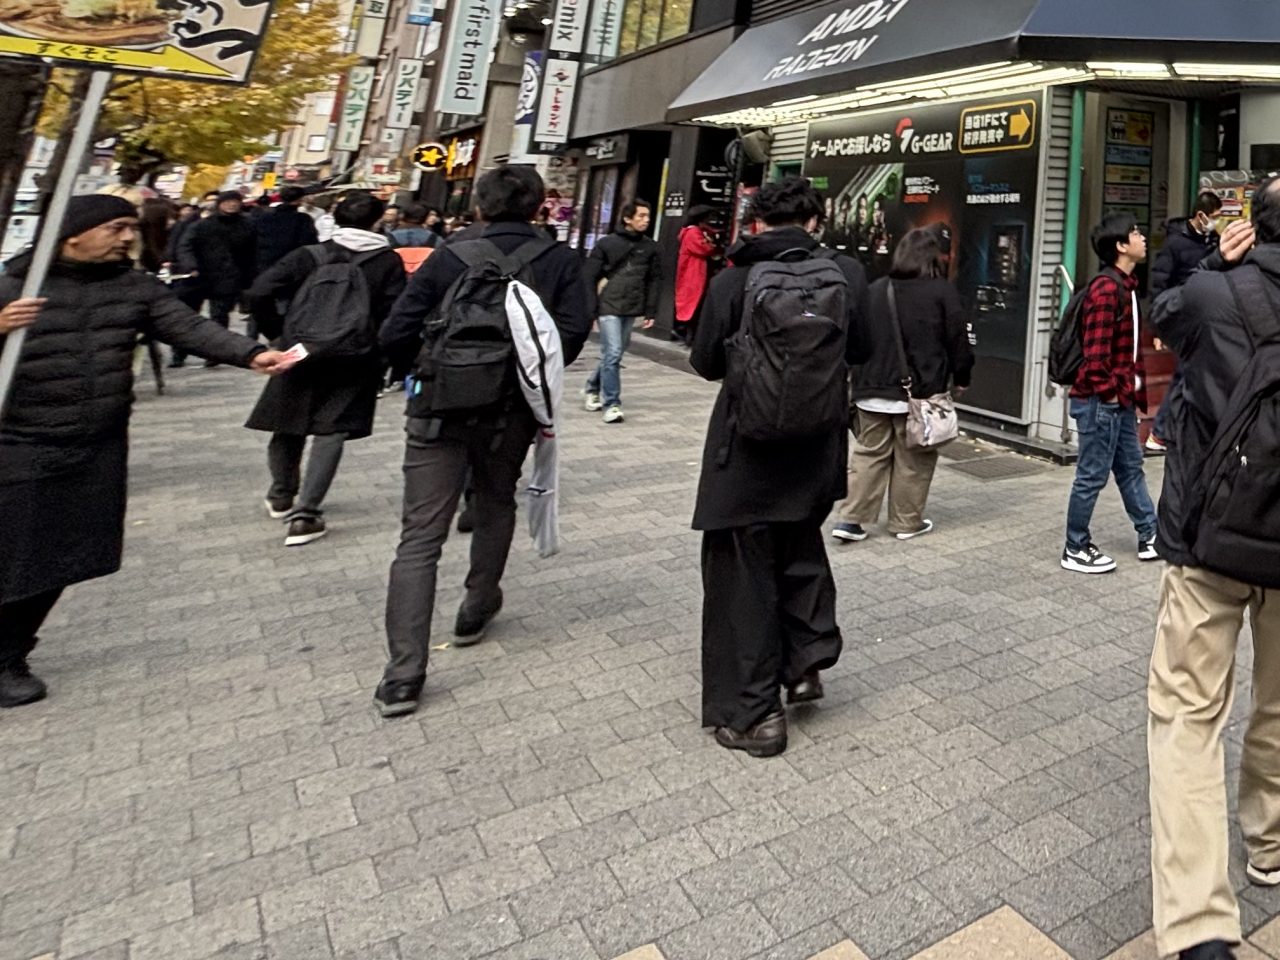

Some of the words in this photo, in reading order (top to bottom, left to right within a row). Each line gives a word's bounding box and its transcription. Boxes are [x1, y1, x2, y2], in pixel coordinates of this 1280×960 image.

[465, 6, 490, 50] first
[35, 42, 120, 61] すぐそこ
[763, 35, 879, 81] RADEON
[395, 64, 417, 123] リバティー
[454, 53, 478, 100] maid
[345, 70, 370, 144] リバティー
[911, 132, 953, 154] G-GEAR
